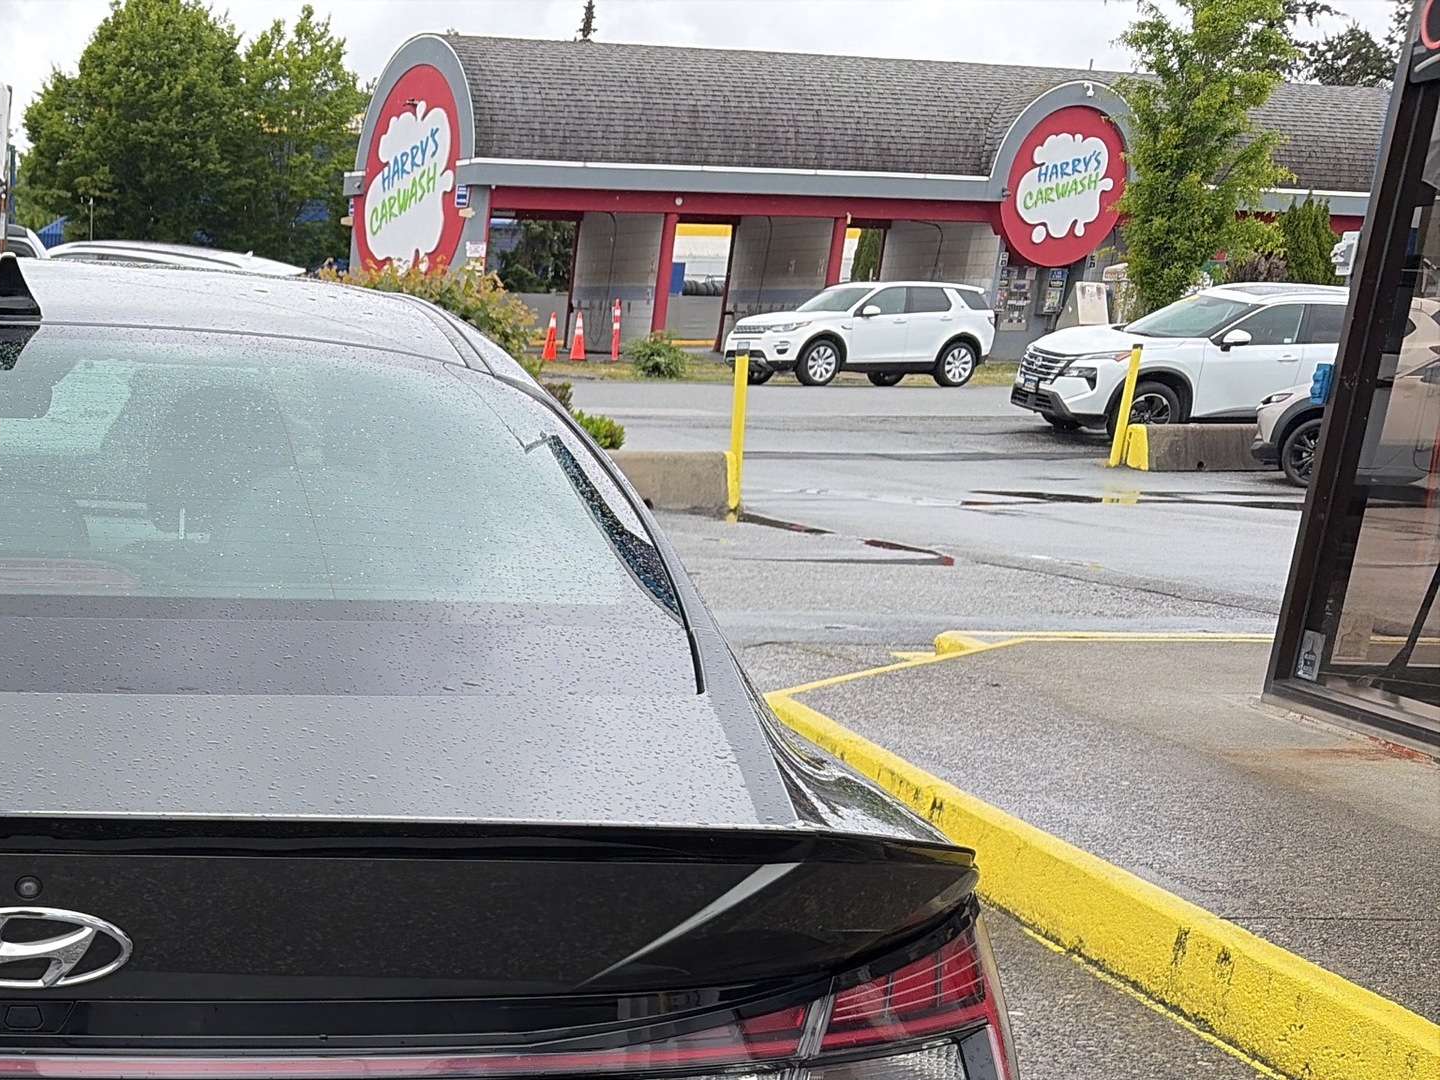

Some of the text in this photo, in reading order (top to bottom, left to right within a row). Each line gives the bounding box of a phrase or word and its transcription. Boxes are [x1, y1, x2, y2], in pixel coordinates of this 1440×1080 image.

[381, 127, 440, 192] HARRY'S
[1037, 150, 1101, 183] HARRY'S
[369, 162, 438, 236] CARWASH
[1023, 173, 1099, 210] CARWASH
